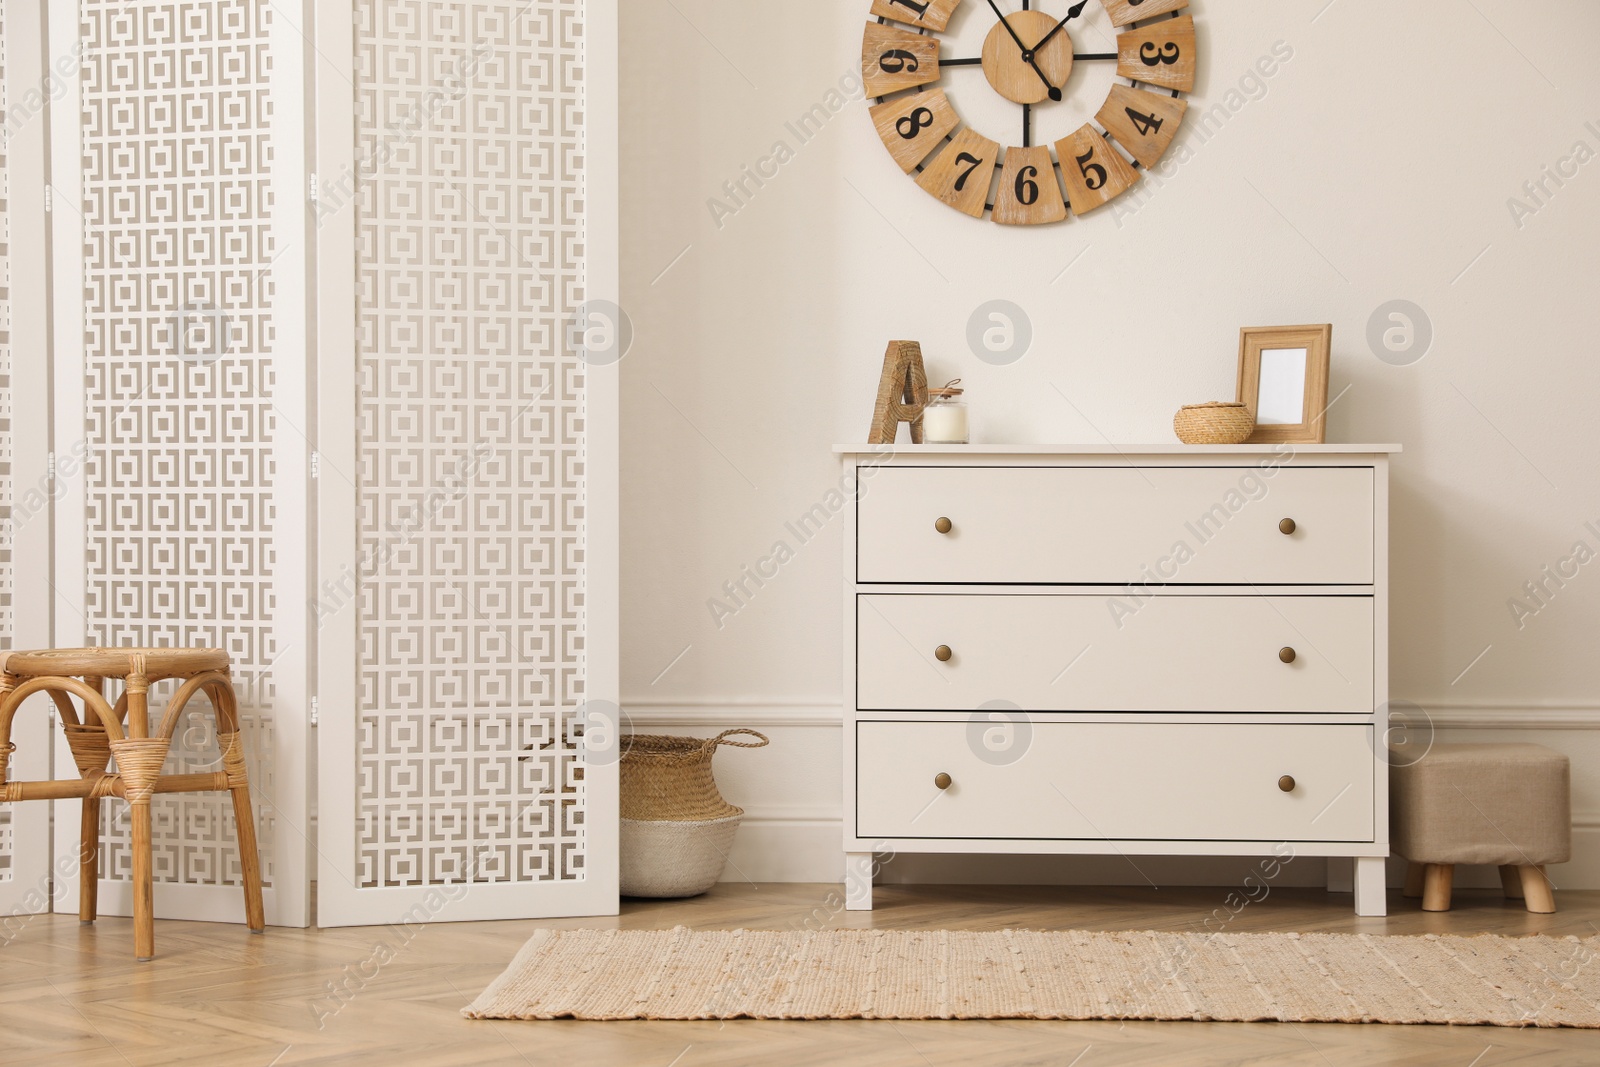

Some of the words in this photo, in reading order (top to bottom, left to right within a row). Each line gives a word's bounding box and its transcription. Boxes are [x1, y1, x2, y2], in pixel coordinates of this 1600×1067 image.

[879, 49, 919, 73] 9
[1139, 41, 1180, 67] 3
[895, 107, 934, 140] 8
[1124, 106, 1164, 136] 4
[954, 151, 983, 192] 7
[1075, 145, 1108, 190] 5
[1014, 165, 1039, 206] 6
